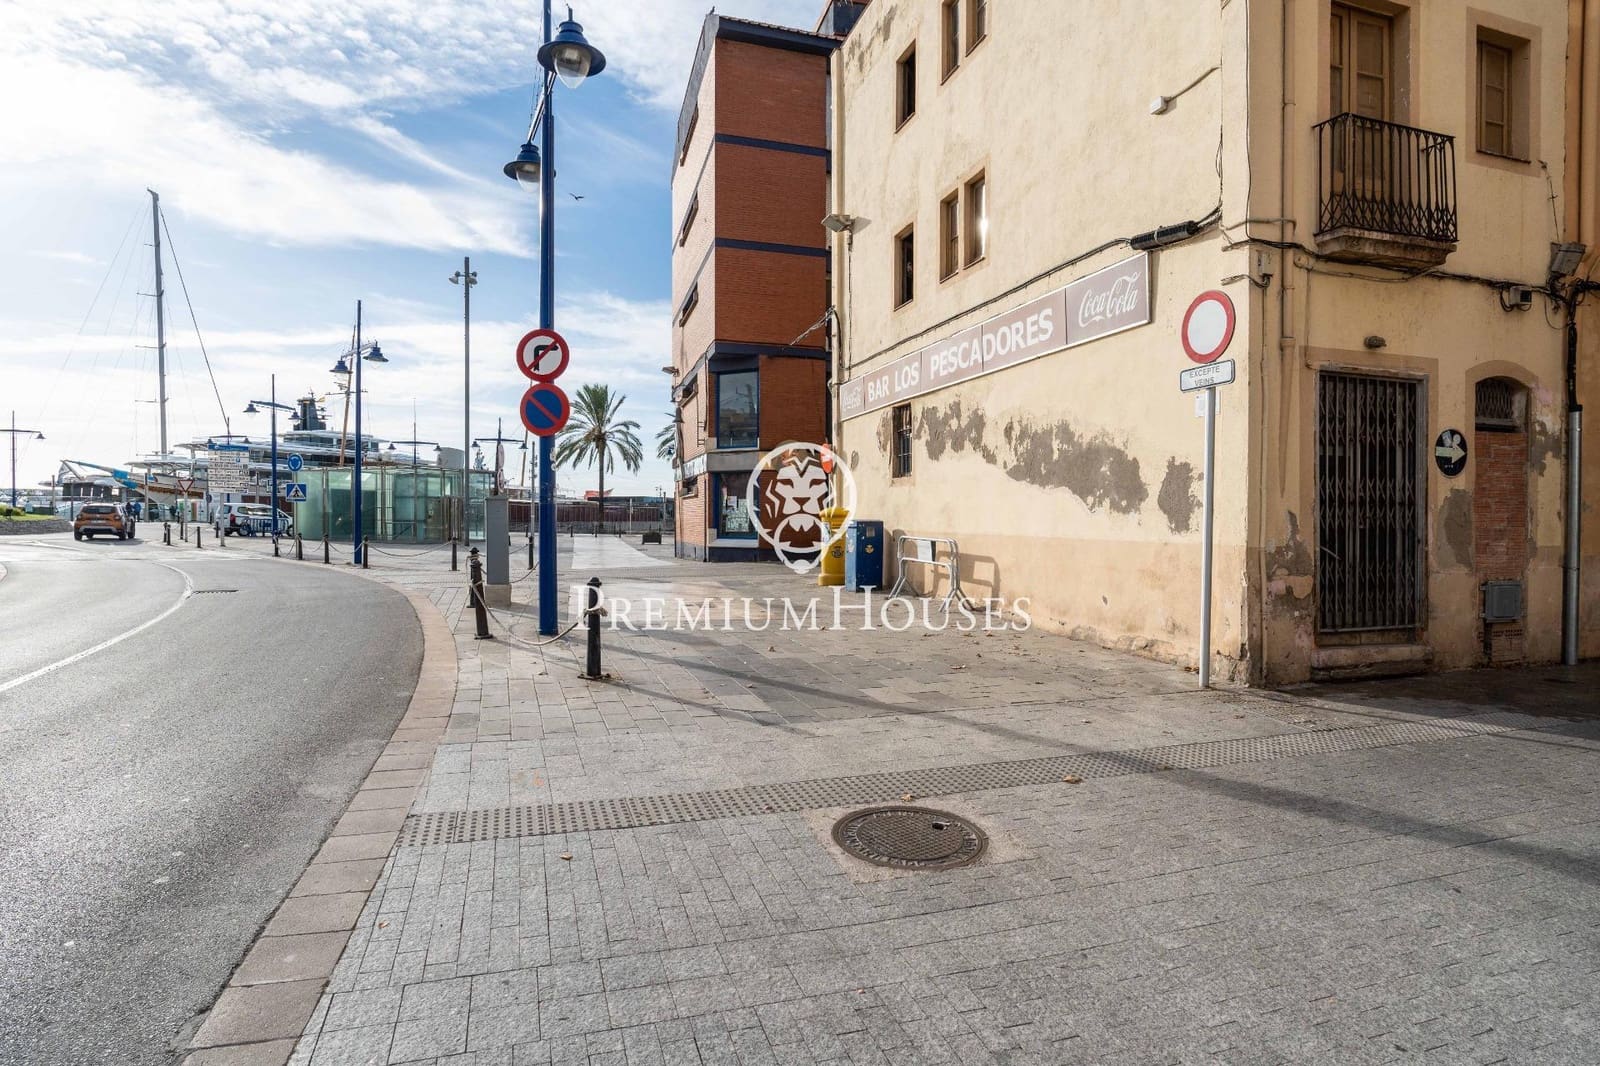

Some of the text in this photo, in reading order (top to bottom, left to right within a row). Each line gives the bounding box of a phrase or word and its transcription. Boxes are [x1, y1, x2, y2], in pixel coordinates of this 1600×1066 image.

[1078, 271, 1141, 328] Coca-Cola
[867, 376, 890, 402] BAR
[894, 361, 920, 393] LOS
[930, 308, 1054, 380] PESCADORES
[1189, 365, 1221, 379] EXCEPTE
